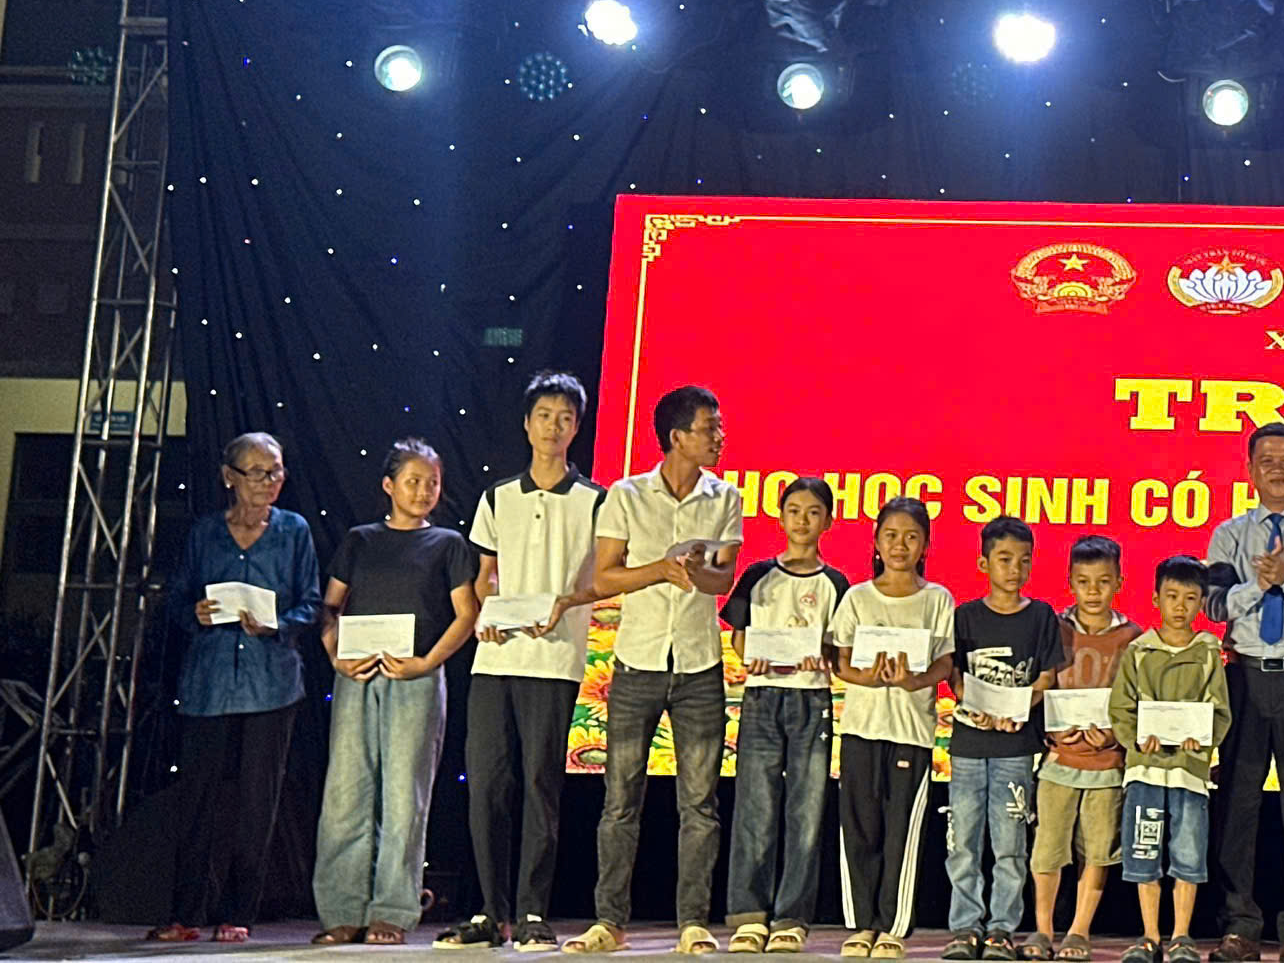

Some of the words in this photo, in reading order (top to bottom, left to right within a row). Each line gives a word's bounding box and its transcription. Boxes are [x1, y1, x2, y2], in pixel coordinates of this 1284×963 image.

[703, 470, 799, 518] HO
[962, 475, 1110, 525] SINH
[1130, 470, 1210, 528] CÓ
